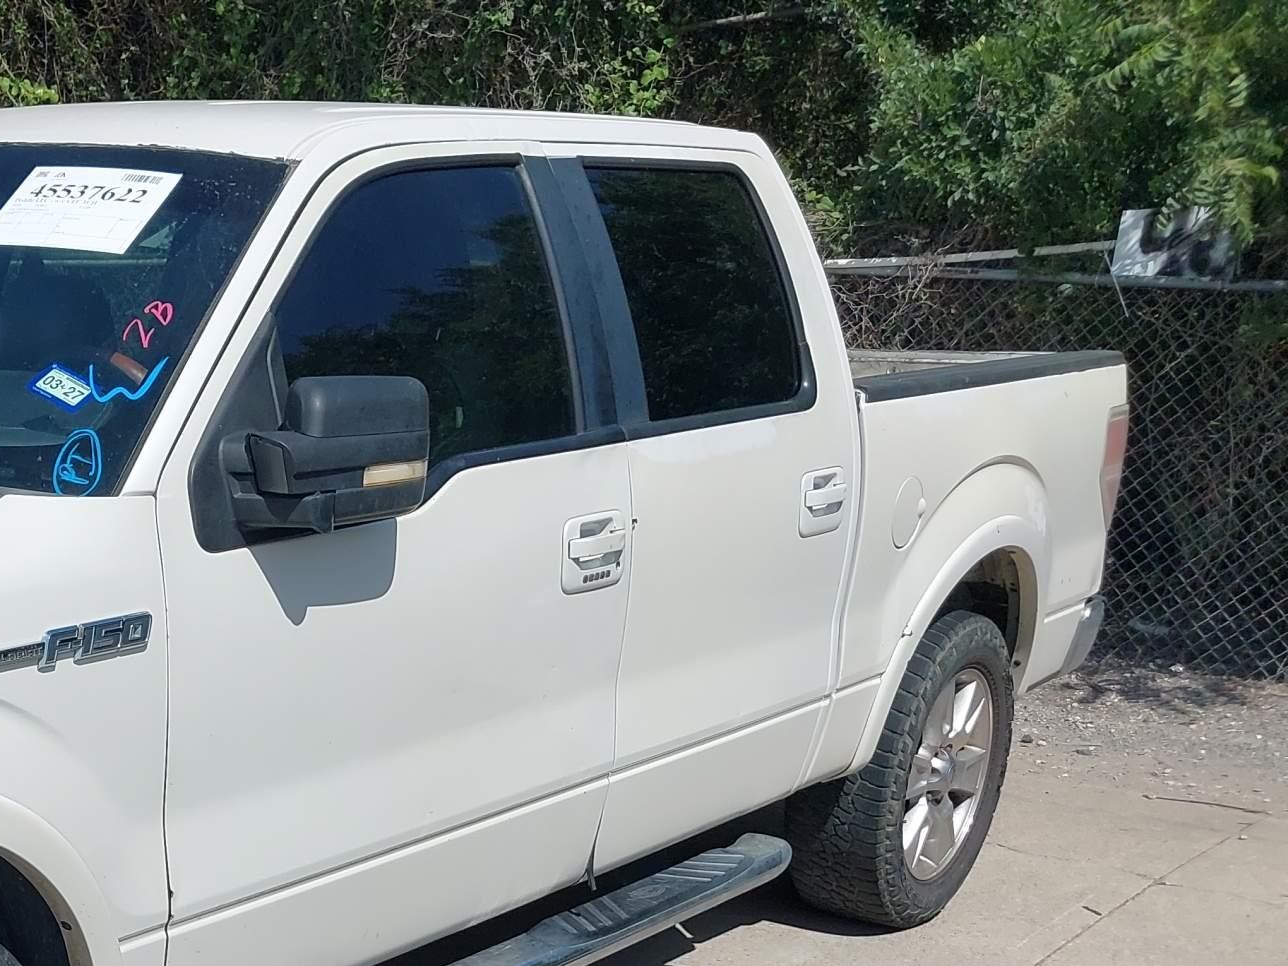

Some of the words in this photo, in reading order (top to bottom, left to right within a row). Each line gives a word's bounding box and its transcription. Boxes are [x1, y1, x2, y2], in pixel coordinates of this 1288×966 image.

[30, 183, 149, 205] 45537622
[42, 375, 63, 390] 03
[62, 386, 85, 400] 27
[37, 610, 153, 674] F-150
